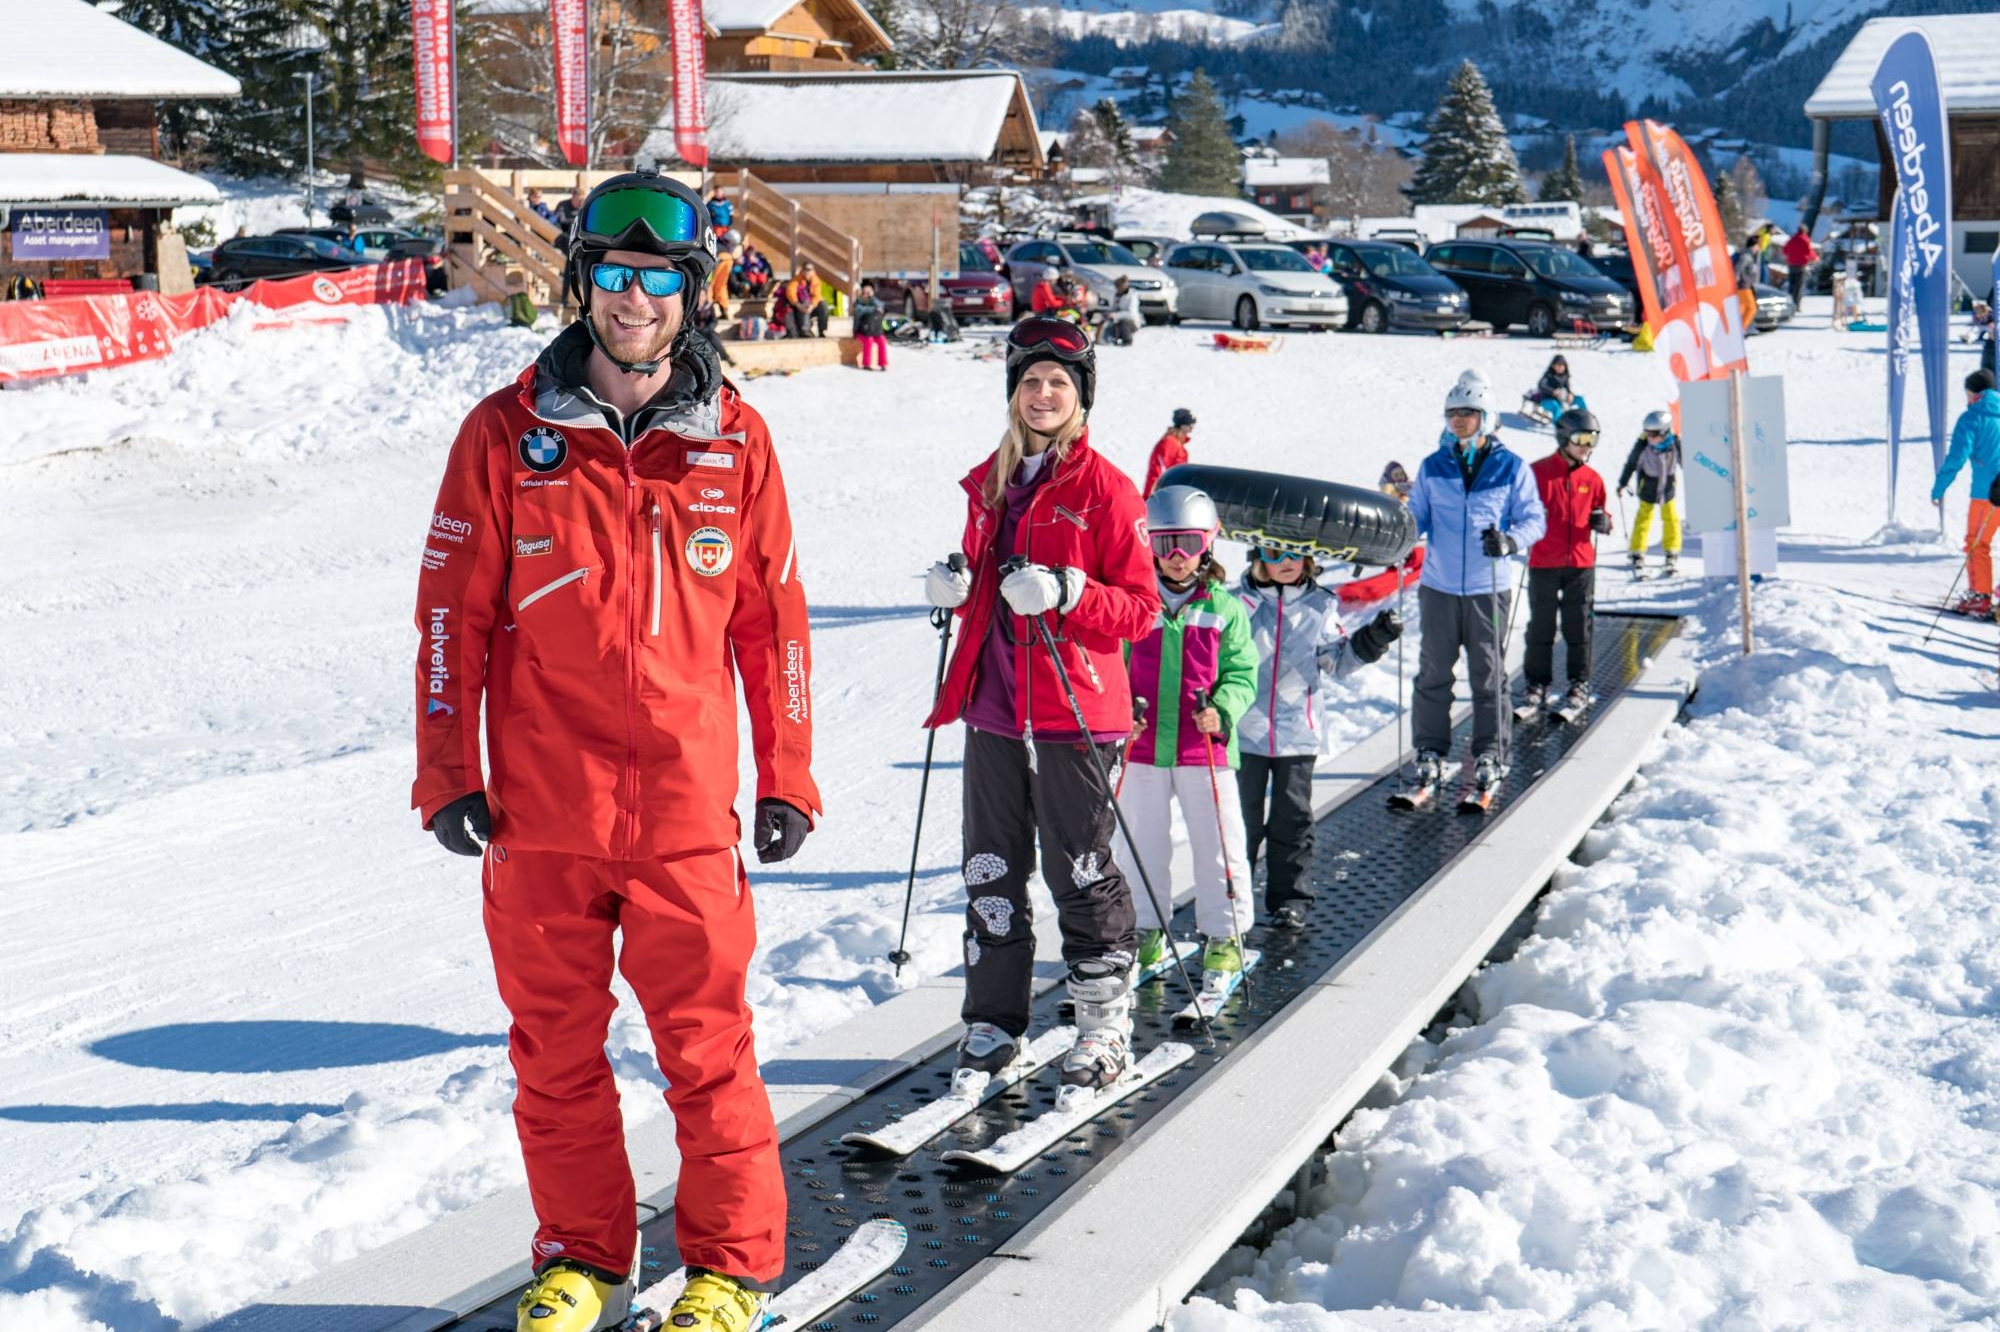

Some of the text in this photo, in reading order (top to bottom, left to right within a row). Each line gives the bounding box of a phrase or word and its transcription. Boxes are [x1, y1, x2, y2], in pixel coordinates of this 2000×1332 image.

[18, 211, 104, 234] Aberdeen
[23, 235, 99, 247] Asset management
[43, 345, 95, 361] ARENA
[523, 427, 563, 442] BMW
[516, 538, 550, 555] Ragusa
[1230, 529, 1359, 561] started
[430, 607, 450, 694] helvetia
[783, 639, 803, 725] Aberdeen
[798, 645, 809, 719] Asset management
